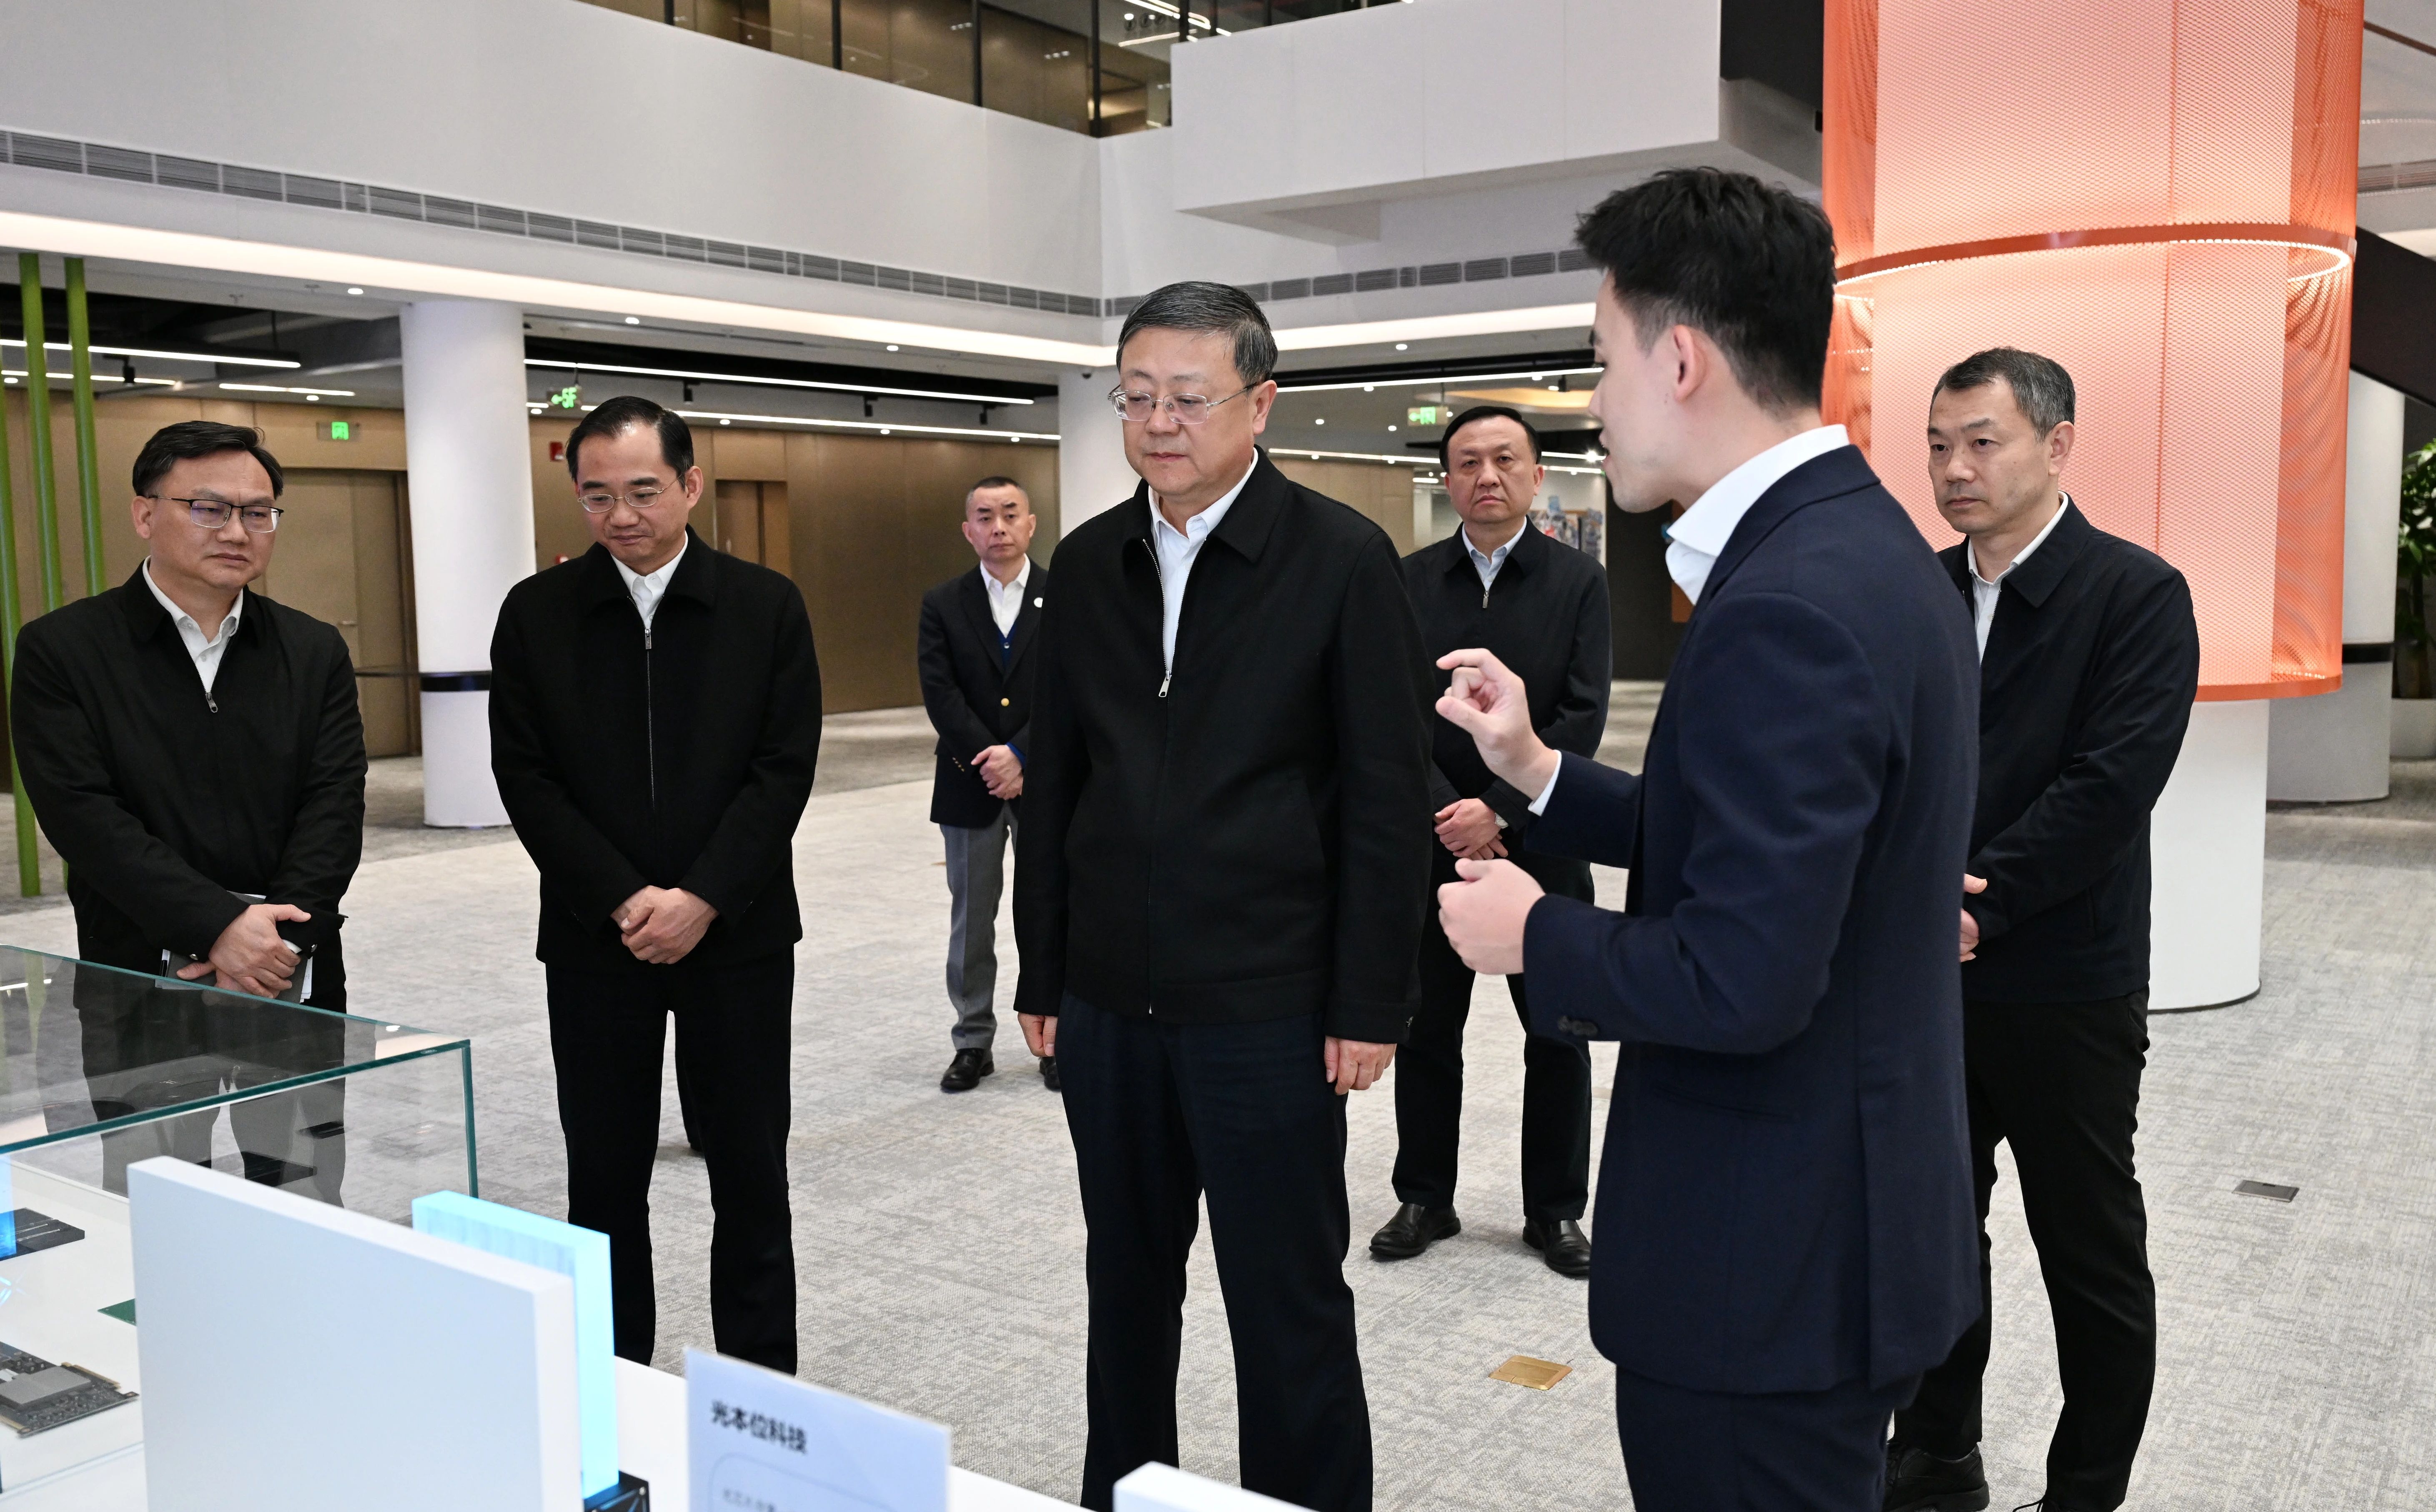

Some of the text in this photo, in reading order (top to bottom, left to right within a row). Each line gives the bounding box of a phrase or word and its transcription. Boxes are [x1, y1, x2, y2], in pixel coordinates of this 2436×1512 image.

[710, 1400, 807, 1454] 光本位科技
